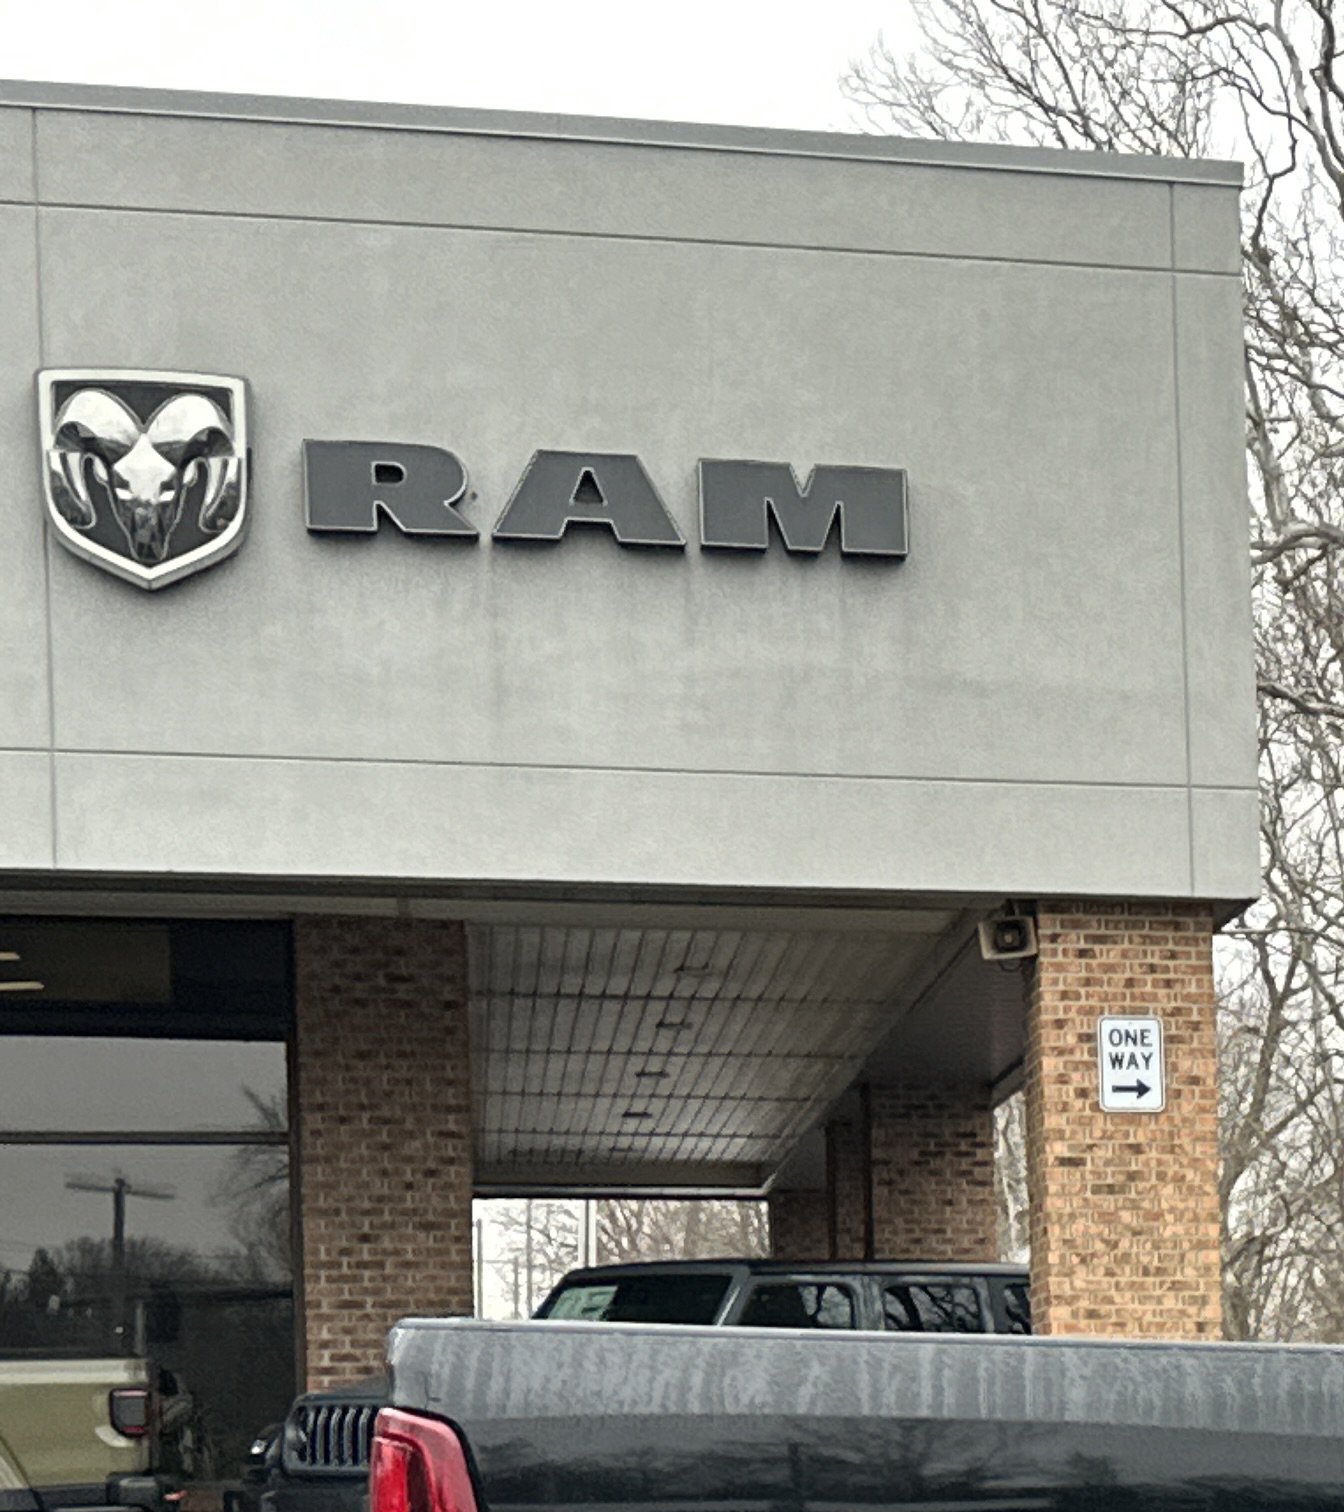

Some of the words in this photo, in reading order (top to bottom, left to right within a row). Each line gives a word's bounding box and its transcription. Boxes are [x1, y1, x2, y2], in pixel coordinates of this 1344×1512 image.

[302, 438, 909, 558] RAM
[1108, 1028, 1153, 1047] ONE
[1108, 1052, 1153, 1070] WAY
